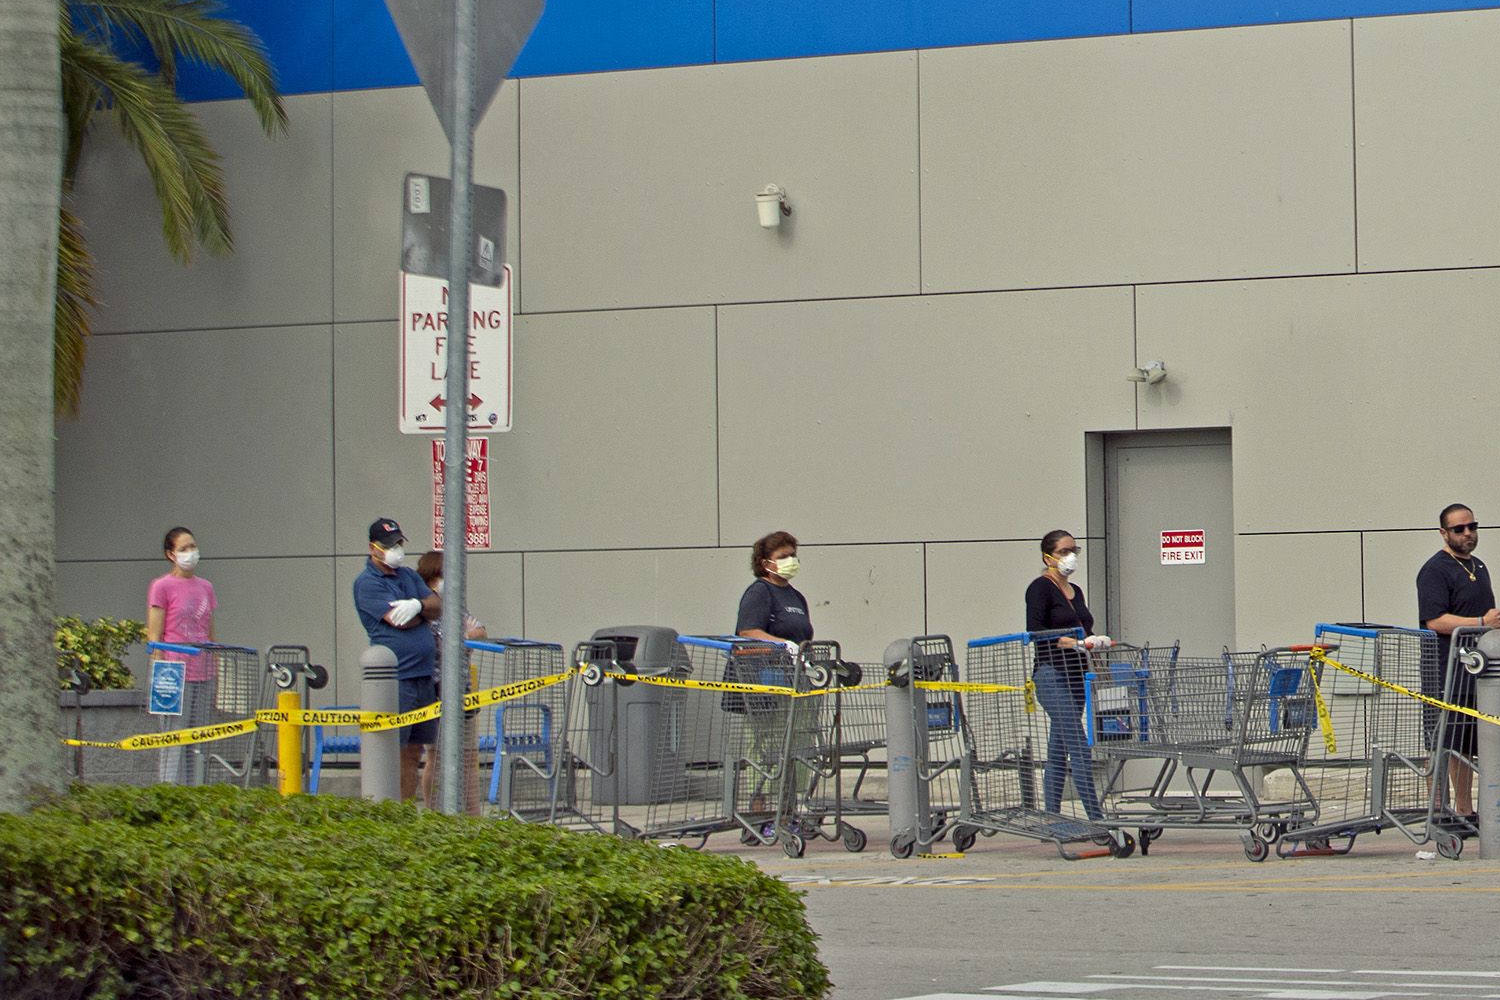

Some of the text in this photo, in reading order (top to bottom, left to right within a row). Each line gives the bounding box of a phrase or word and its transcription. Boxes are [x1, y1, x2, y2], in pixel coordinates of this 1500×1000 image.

[412, 311, 501, 331] PARNG
[436, 334, 477, 355] FE
[1162, 535, 1204, 544] DO NOT BLOCK
[1162, 550, 1204, 560] FIRE EXIT
[491, 679, 545, 701] CAUTION
[302, 712, 361, 723] CAUTION
[389, 711, 428, 726] CAUTION
[191, 723, 243, 741] CAUTION
[131, 733, 181, 748] CAUTION
